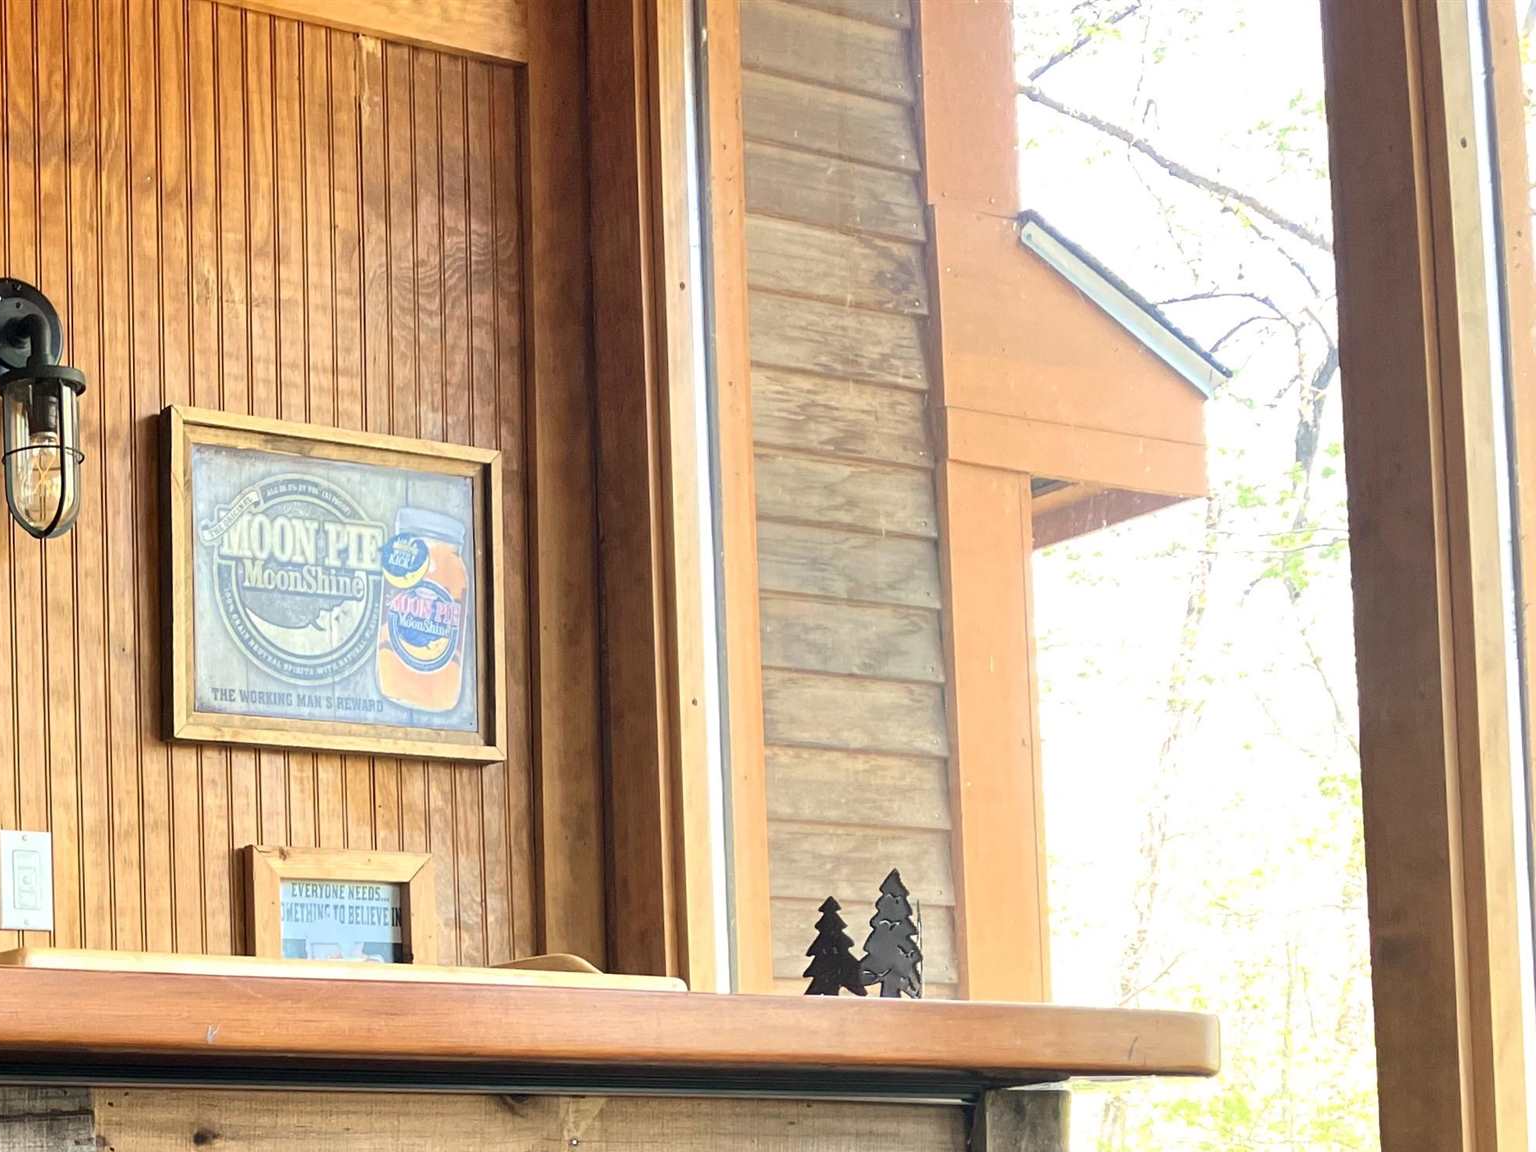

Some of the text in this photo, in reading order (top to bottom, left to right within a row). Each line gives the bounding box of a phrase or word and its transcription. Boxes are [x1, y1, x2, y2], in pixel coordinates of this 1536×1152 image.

[218, 508, 382, 570] MOON PIE
[243, 559, 366, 597] MoonShine
[211, 687, 236, 702] THE
[239, 690, 293, 707] WORKING
[336, 697, 384, 713] REWARD
[291, 882, 390, 902] EVERYONE NEEDS...
[333, 904, 345, 924] TO
[348, 905, 389, 926] BELIEVE
